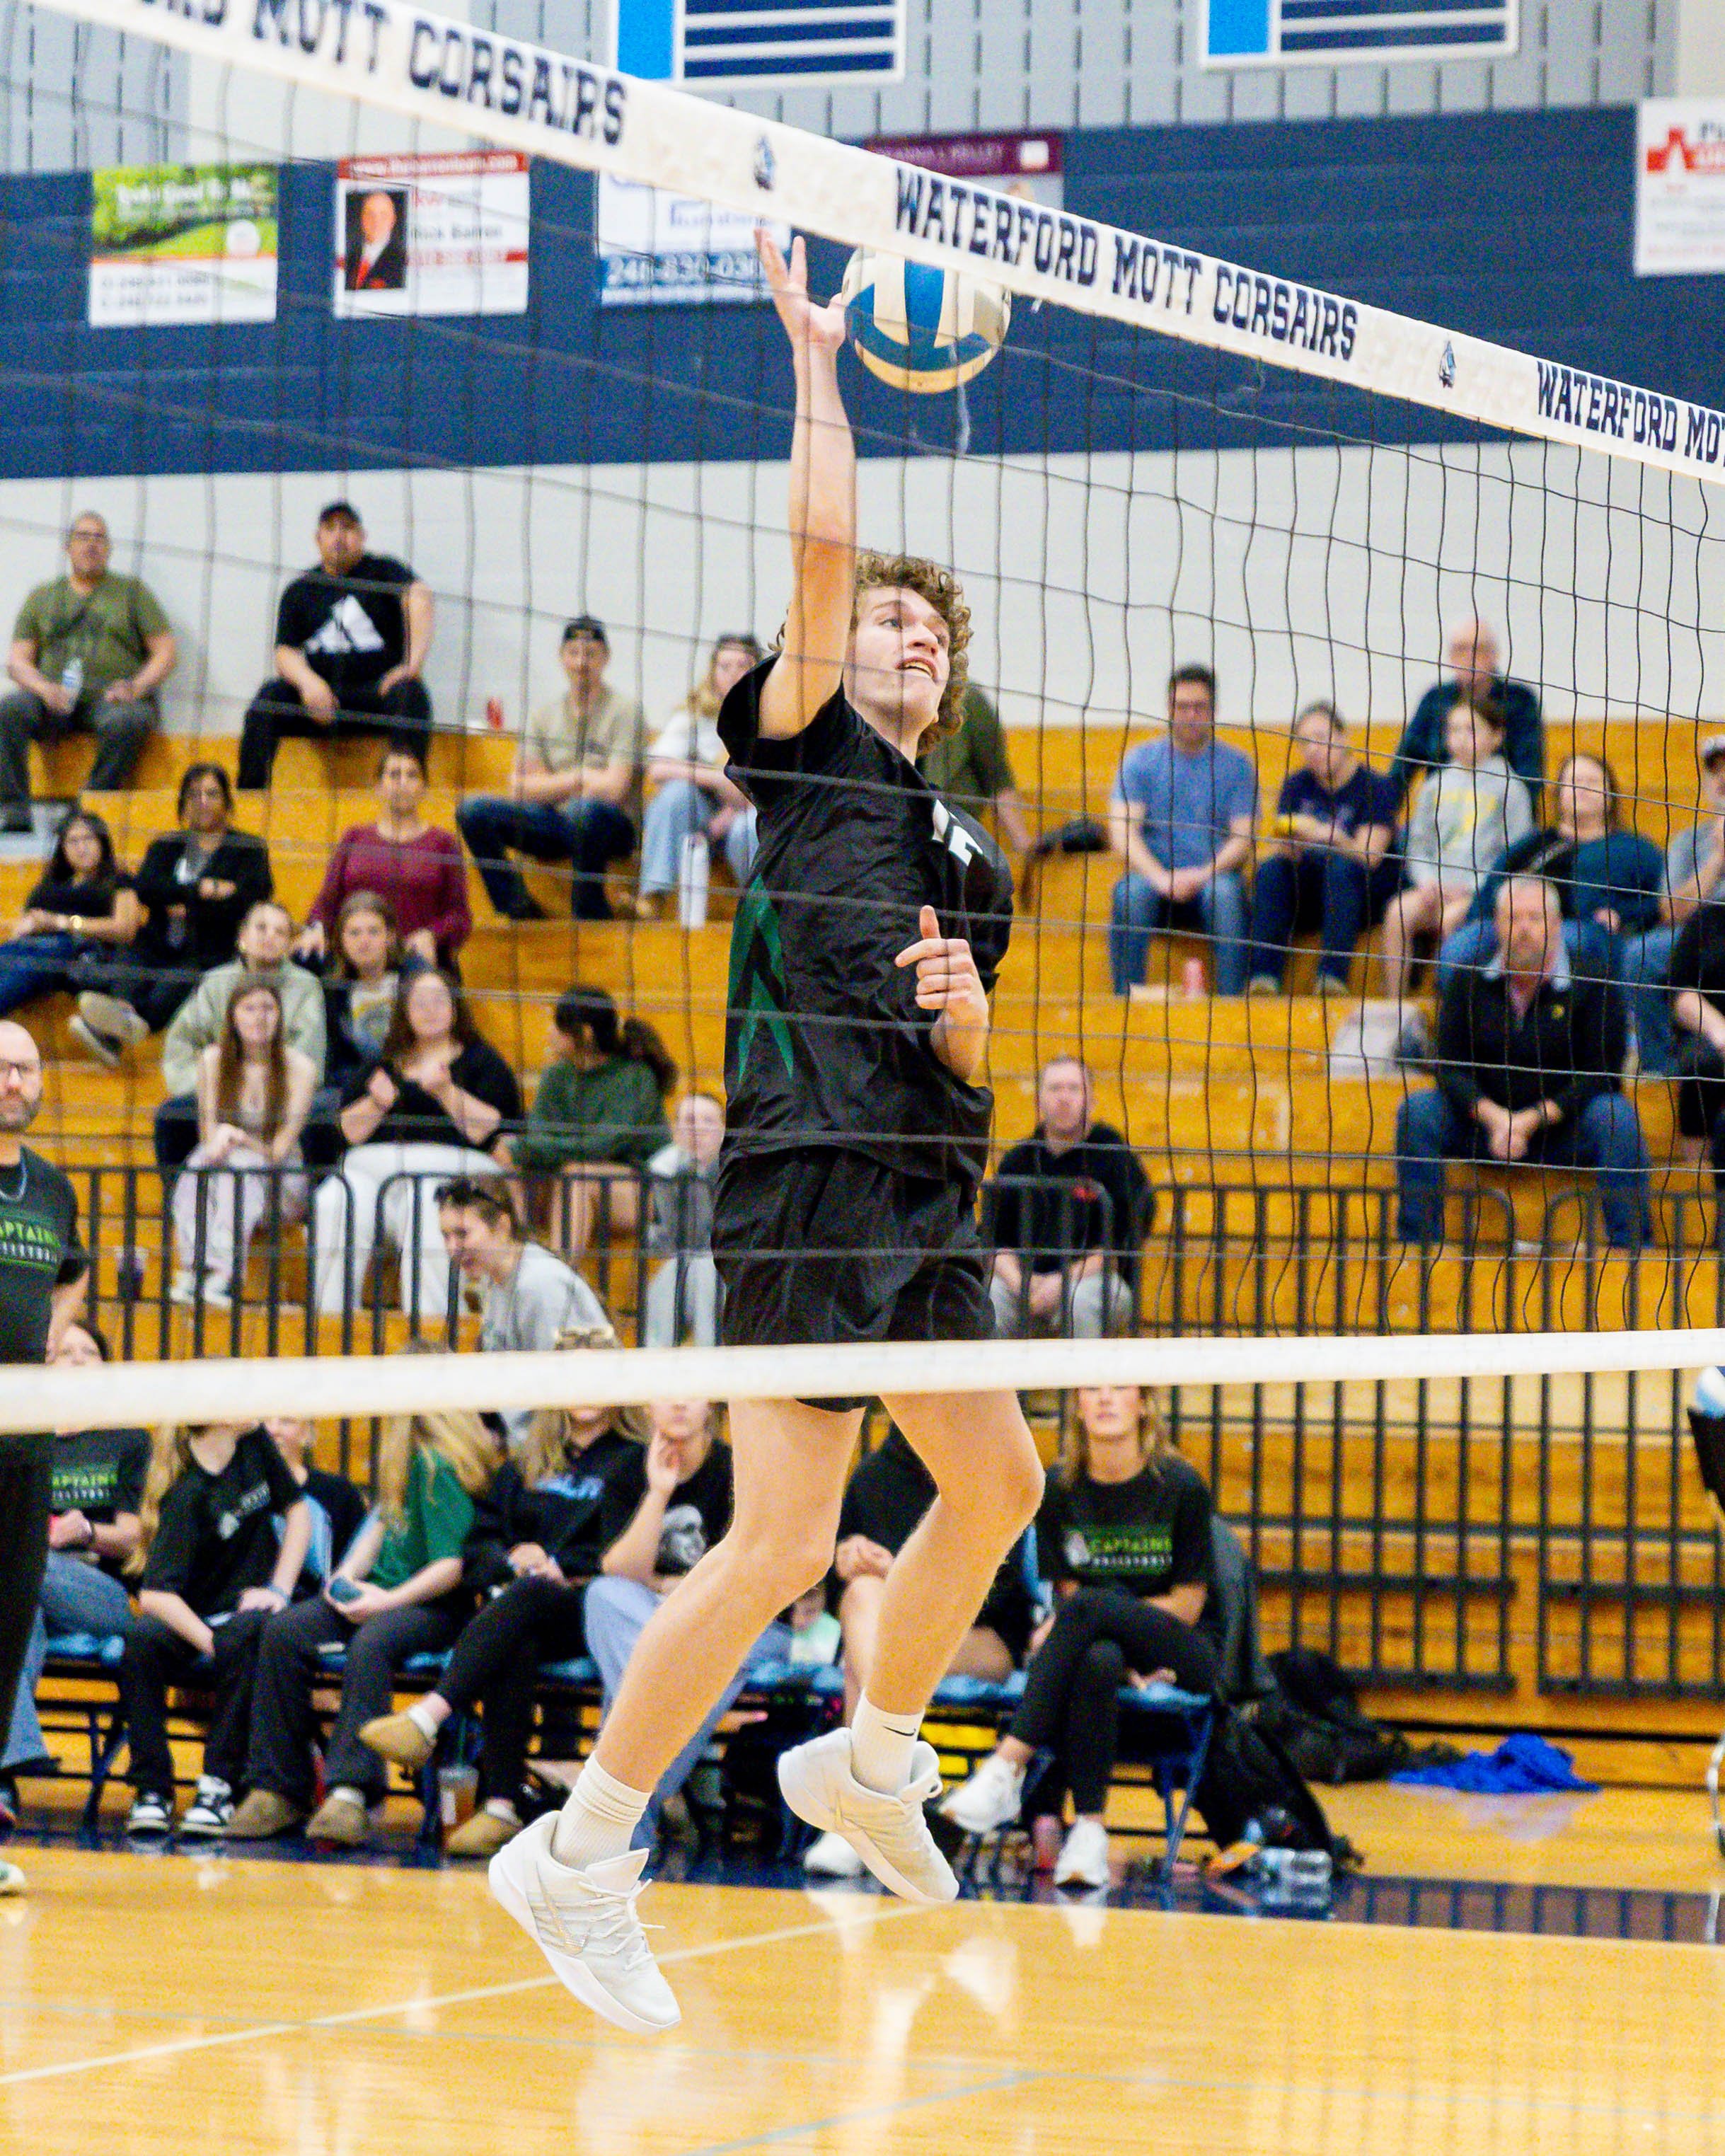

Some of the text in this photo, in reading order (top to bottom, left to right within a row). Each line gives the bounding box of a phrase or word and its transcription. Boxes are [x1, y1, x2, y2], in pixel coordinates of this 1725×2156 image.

[409, 18, 628, 146] CORSAIRS
[895, 166, 1359, 362] WATERFORD MOTT CORSAIRS
[1537, 360, 1678, 453] WATERFORD
